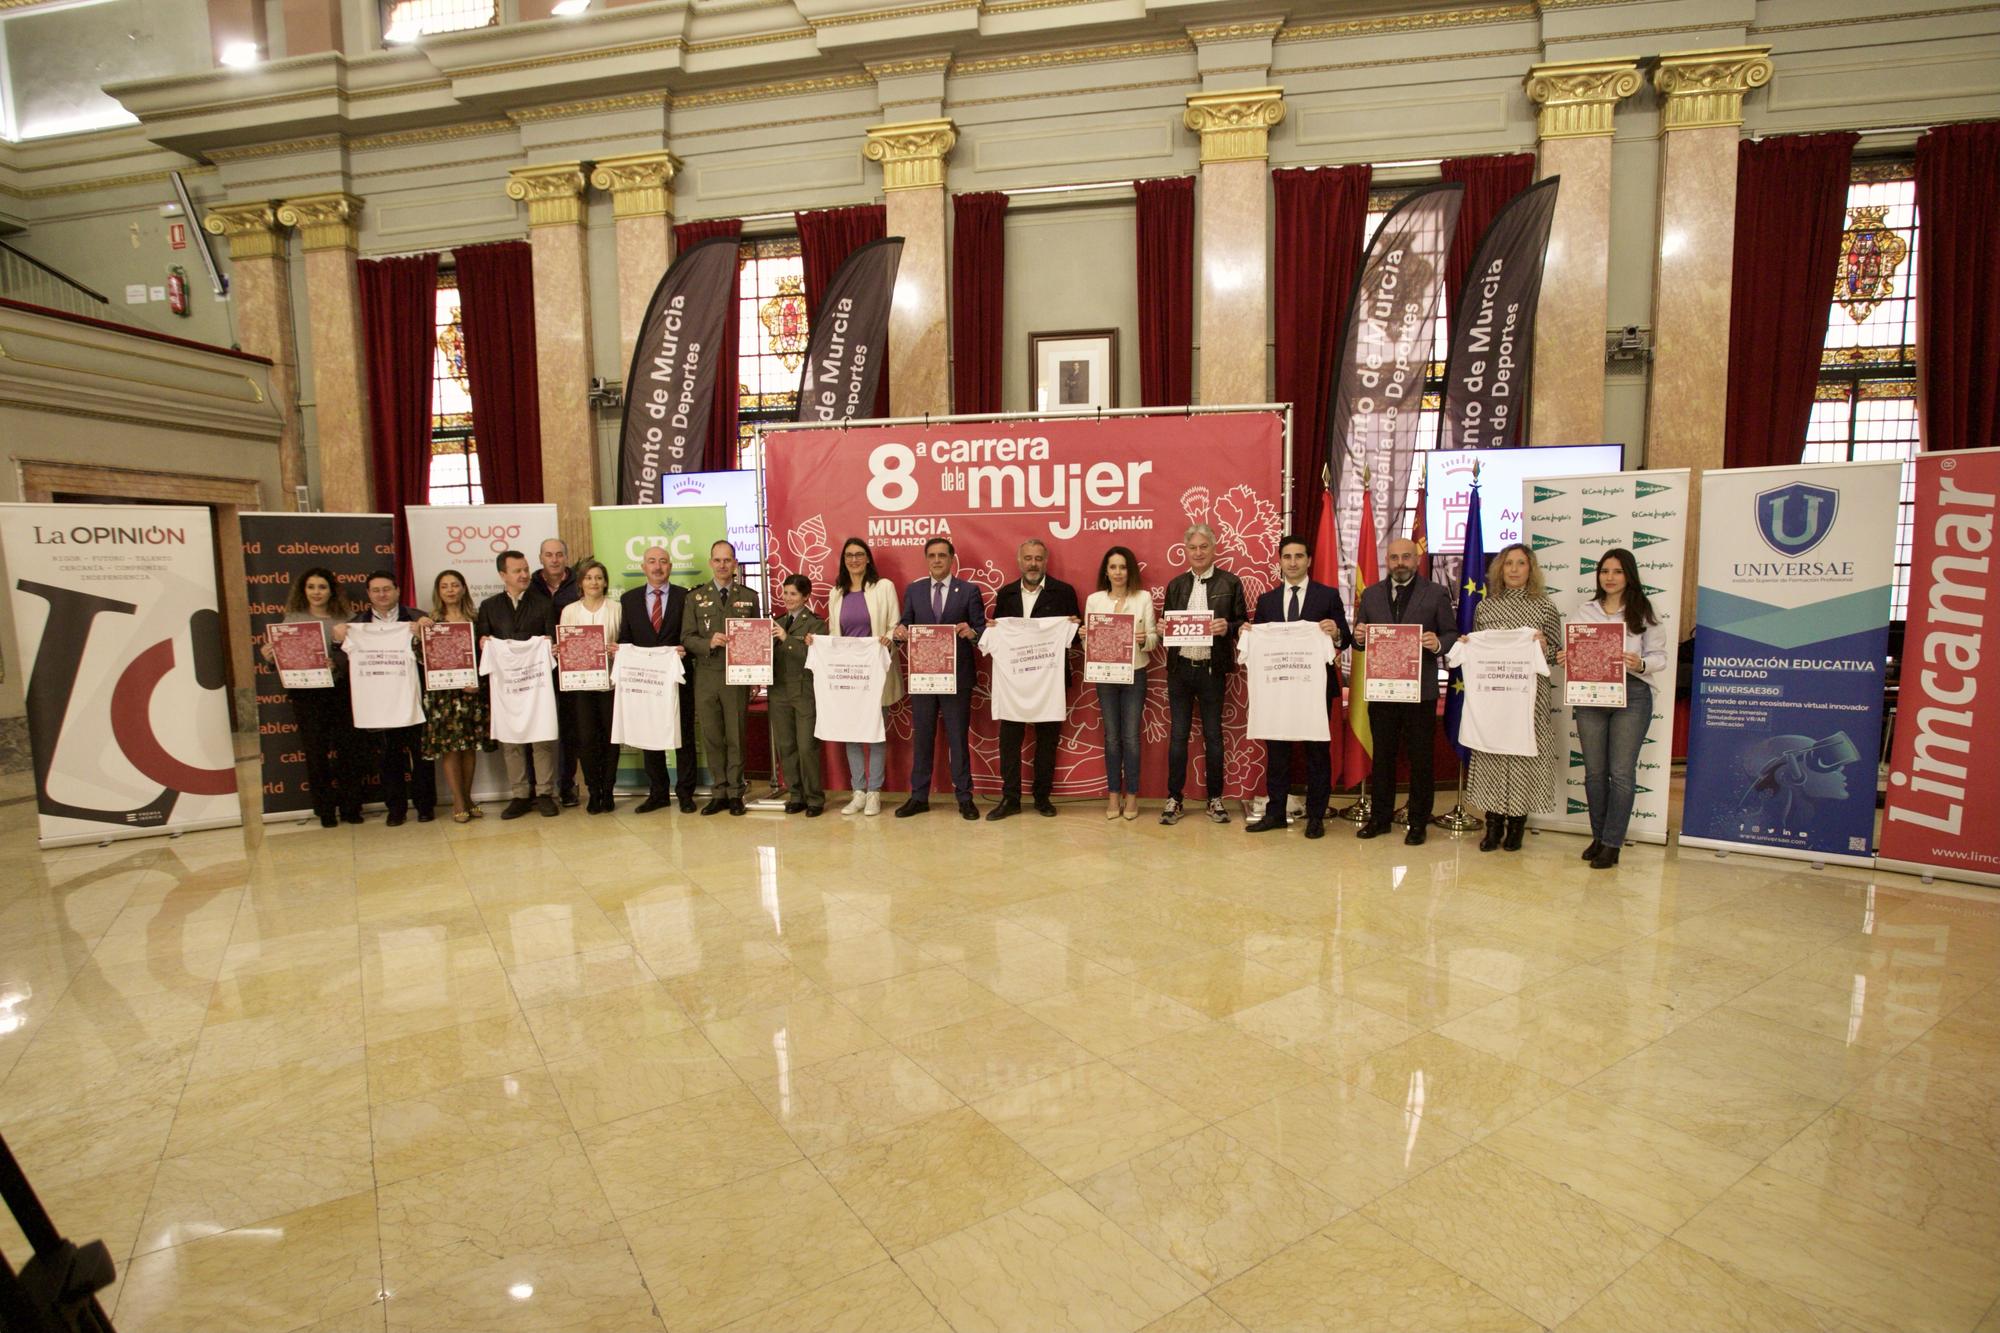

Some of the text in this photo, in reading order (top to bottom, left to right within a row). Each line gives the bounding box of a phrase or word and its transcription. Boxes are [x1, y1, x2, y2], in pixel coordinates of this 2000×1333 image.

[1364, 250, 1403, 346] Murcia
[1468, 258, 1503, 352] Murcia
[651, 295, 685, 381] Murcia
[820, 297, 853, 384] Murcia
[1385, 303, 1418, 398] Deportes
[1492, 302, 1518, 397] Deportes
[1357, 353, 1382, 388] de
[1463, 360, 1486, 393] de
[672, 342, 700, 428] Deportes
[645, 389, 668, 419] de
[1490, 404, 1508, 430] de
[1384, 406, 1398, 433] de
[668, 436, 685, 459] de
[931, 436, 1050, 464] carrera
[968, 460, 1153, 540] mujer
[32, 525, 185, 545] La OPINIÓN
[868, 518, 951, 537] MURCIA
[1500, 528, 1517, 540] de
[278, 541, 360, 555] cableworld
[734, 541, 760, 552] Murc
[868, 538, 875, 547] 5
[877, 538, 889, 547] DE
[891, 537, 927, 546] MARZO
[1733, 561, 1855, 577] UNIVERSAE
[1172, 623, 1204, 636] 2023
[1702, 668, 1768, 679] DE CALIDAD
[1703, 656, 1876, 672] INNOVACIÓN EDUCATIVA
[1708, 685, 1780, 696] UNIVERSAE360
[1706, 697, 1736, 706] Aprende
[1760, 700, 1802, 709] ecosistema
[1829, 703, 1869, 711] innovador
